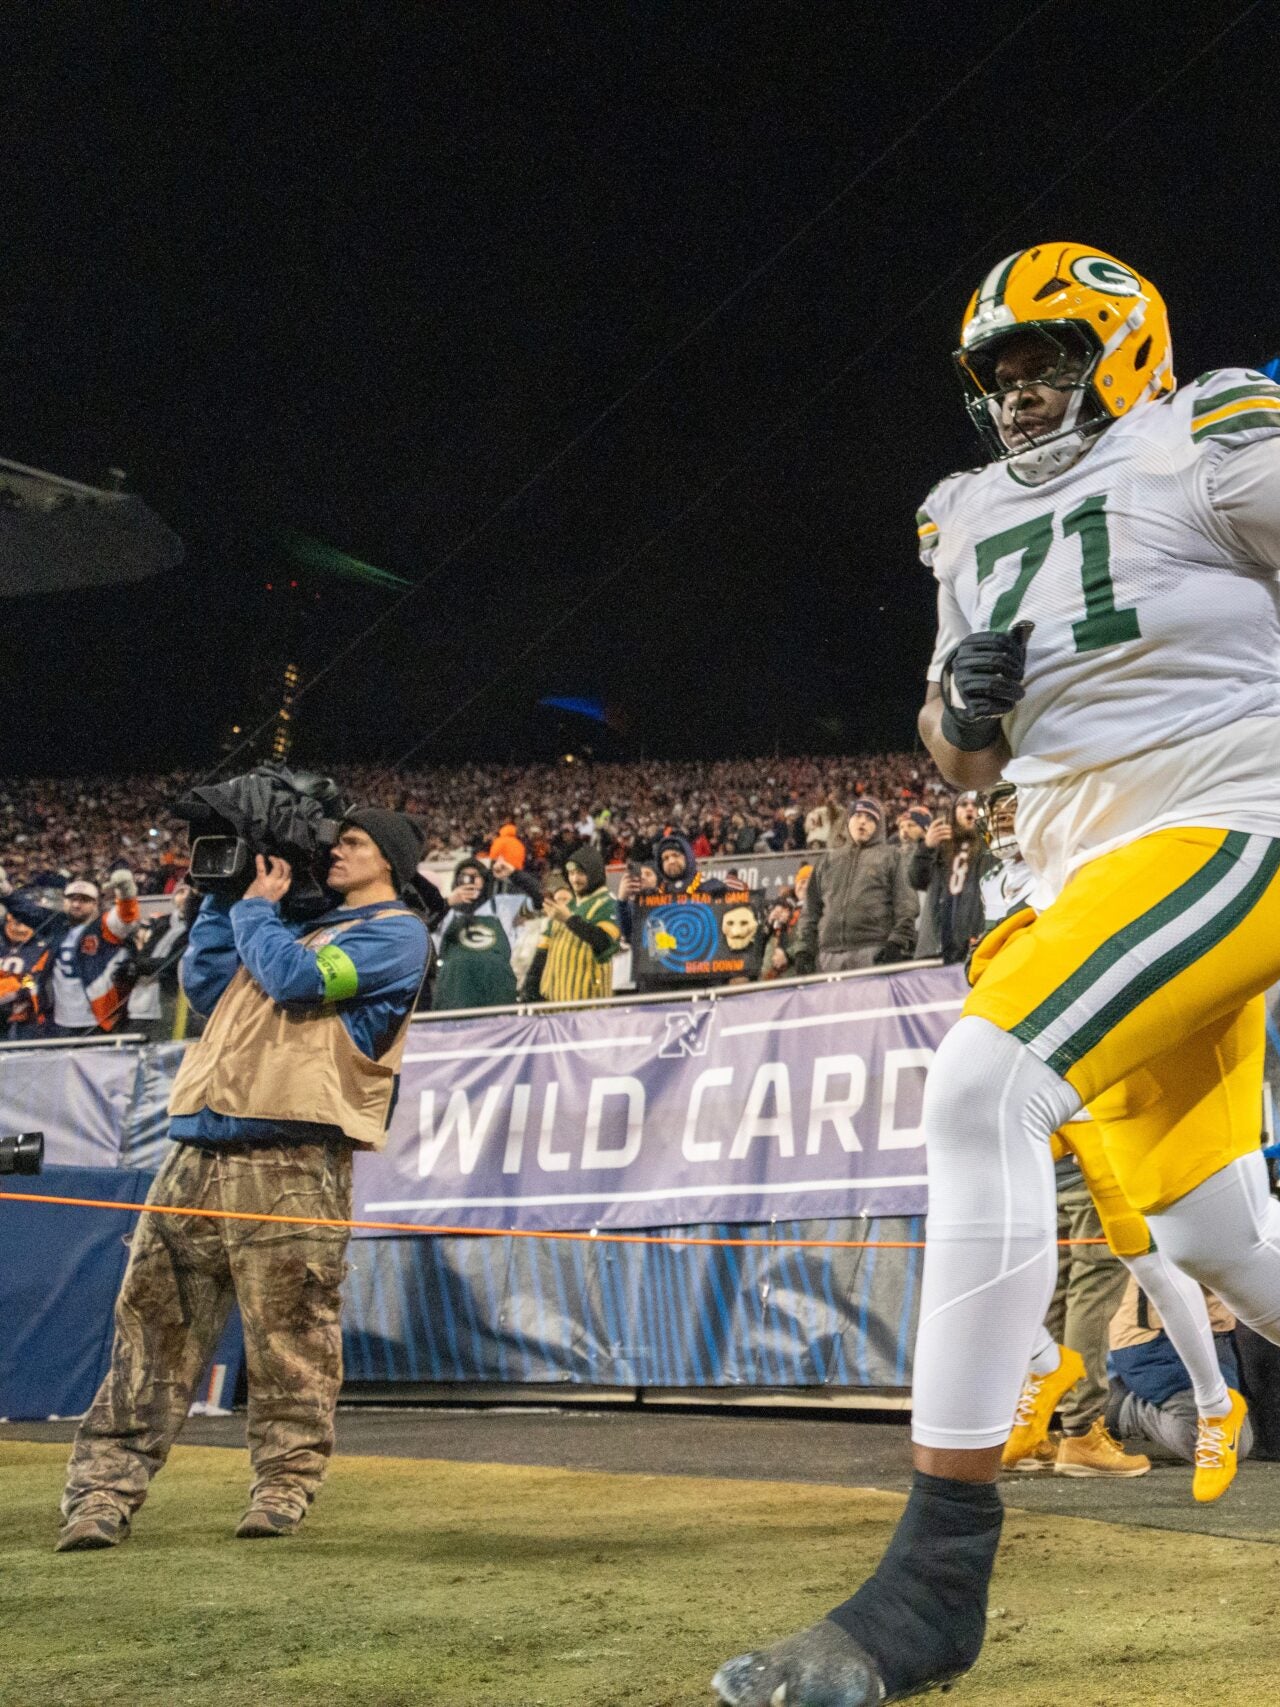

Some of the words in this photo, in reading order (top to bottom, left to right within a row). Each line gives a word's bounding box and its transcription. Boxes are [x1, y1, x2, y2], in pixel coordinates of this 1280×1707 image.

[974, 493, 1142, 653] 71
[418, 1075, 646, 1178] WILD
[681, 1047, 927, 1163] CARD
